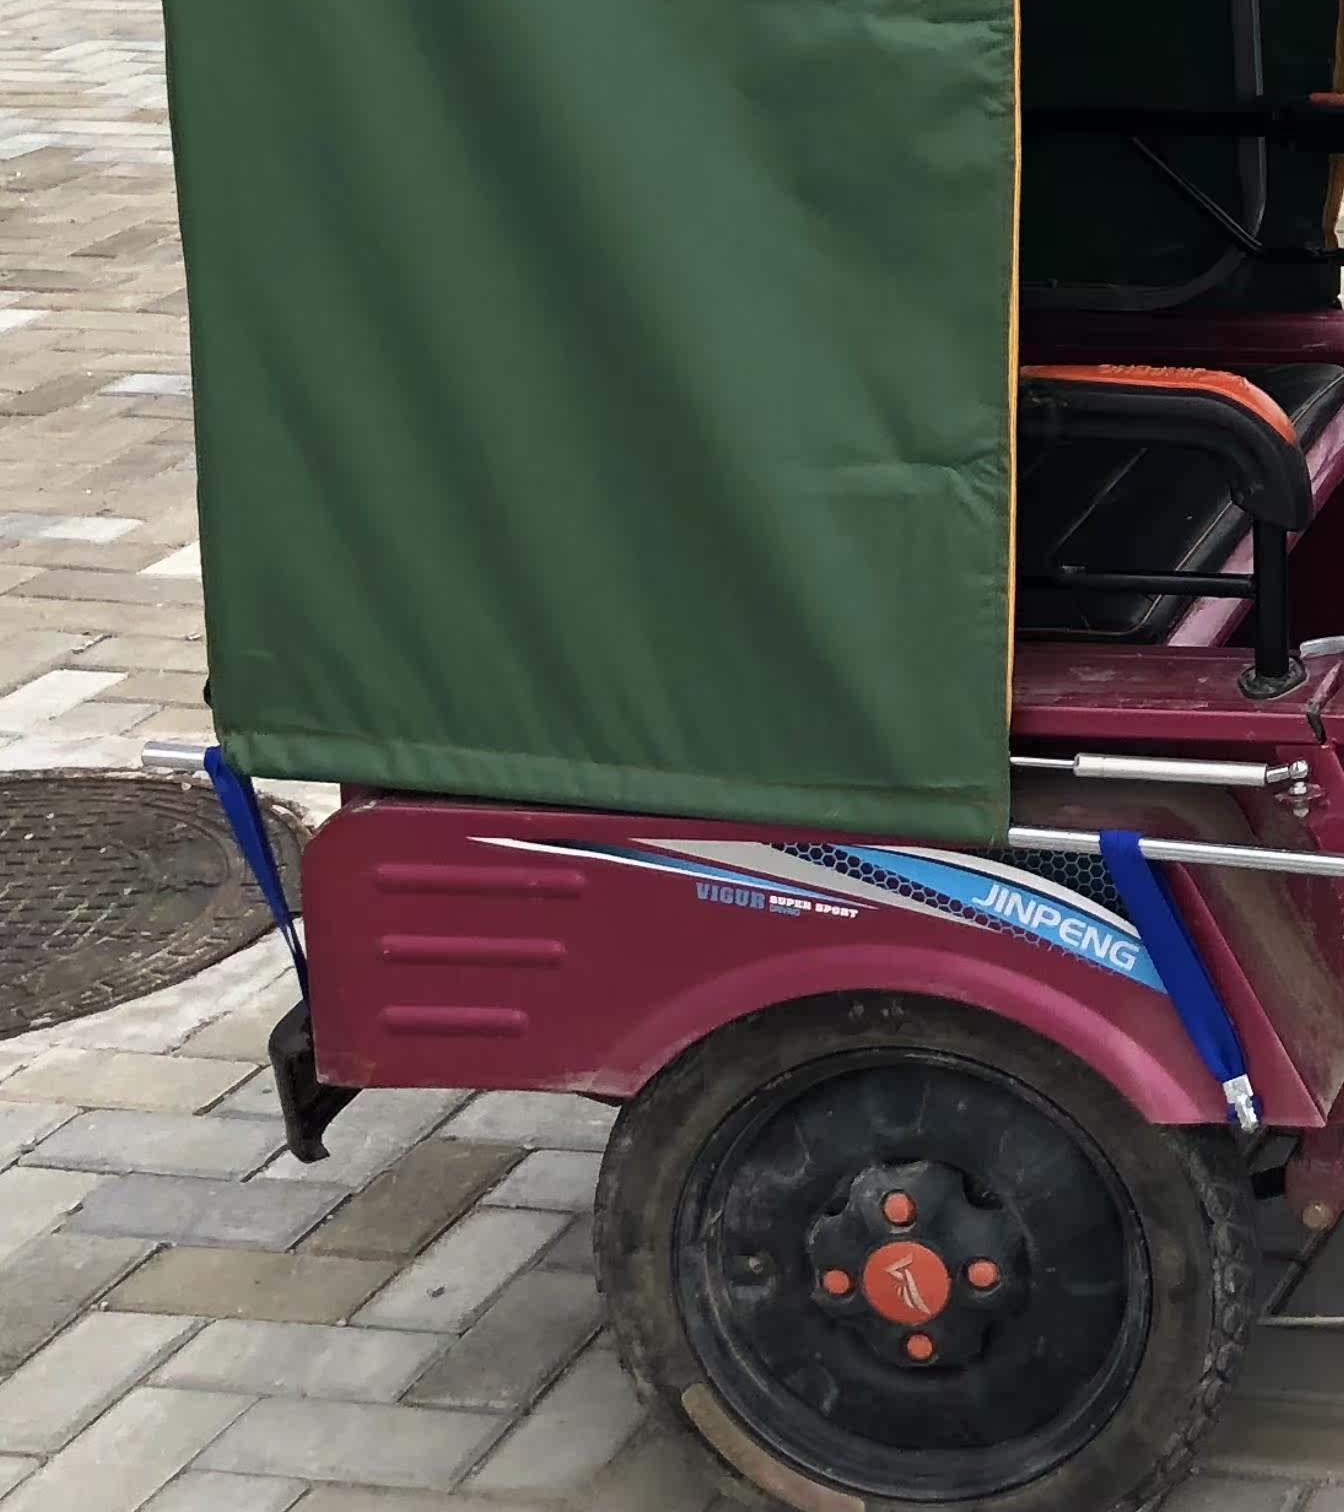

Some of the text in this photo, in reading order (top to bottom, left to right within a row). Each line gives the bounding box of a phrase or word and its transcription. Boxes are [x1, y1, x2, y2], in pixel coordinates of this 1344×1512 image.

[769, 895, 812, 911] SUPER
[814, 902, 859, 919] SPORT
[971, 883, 1140, 972] JINPENG
